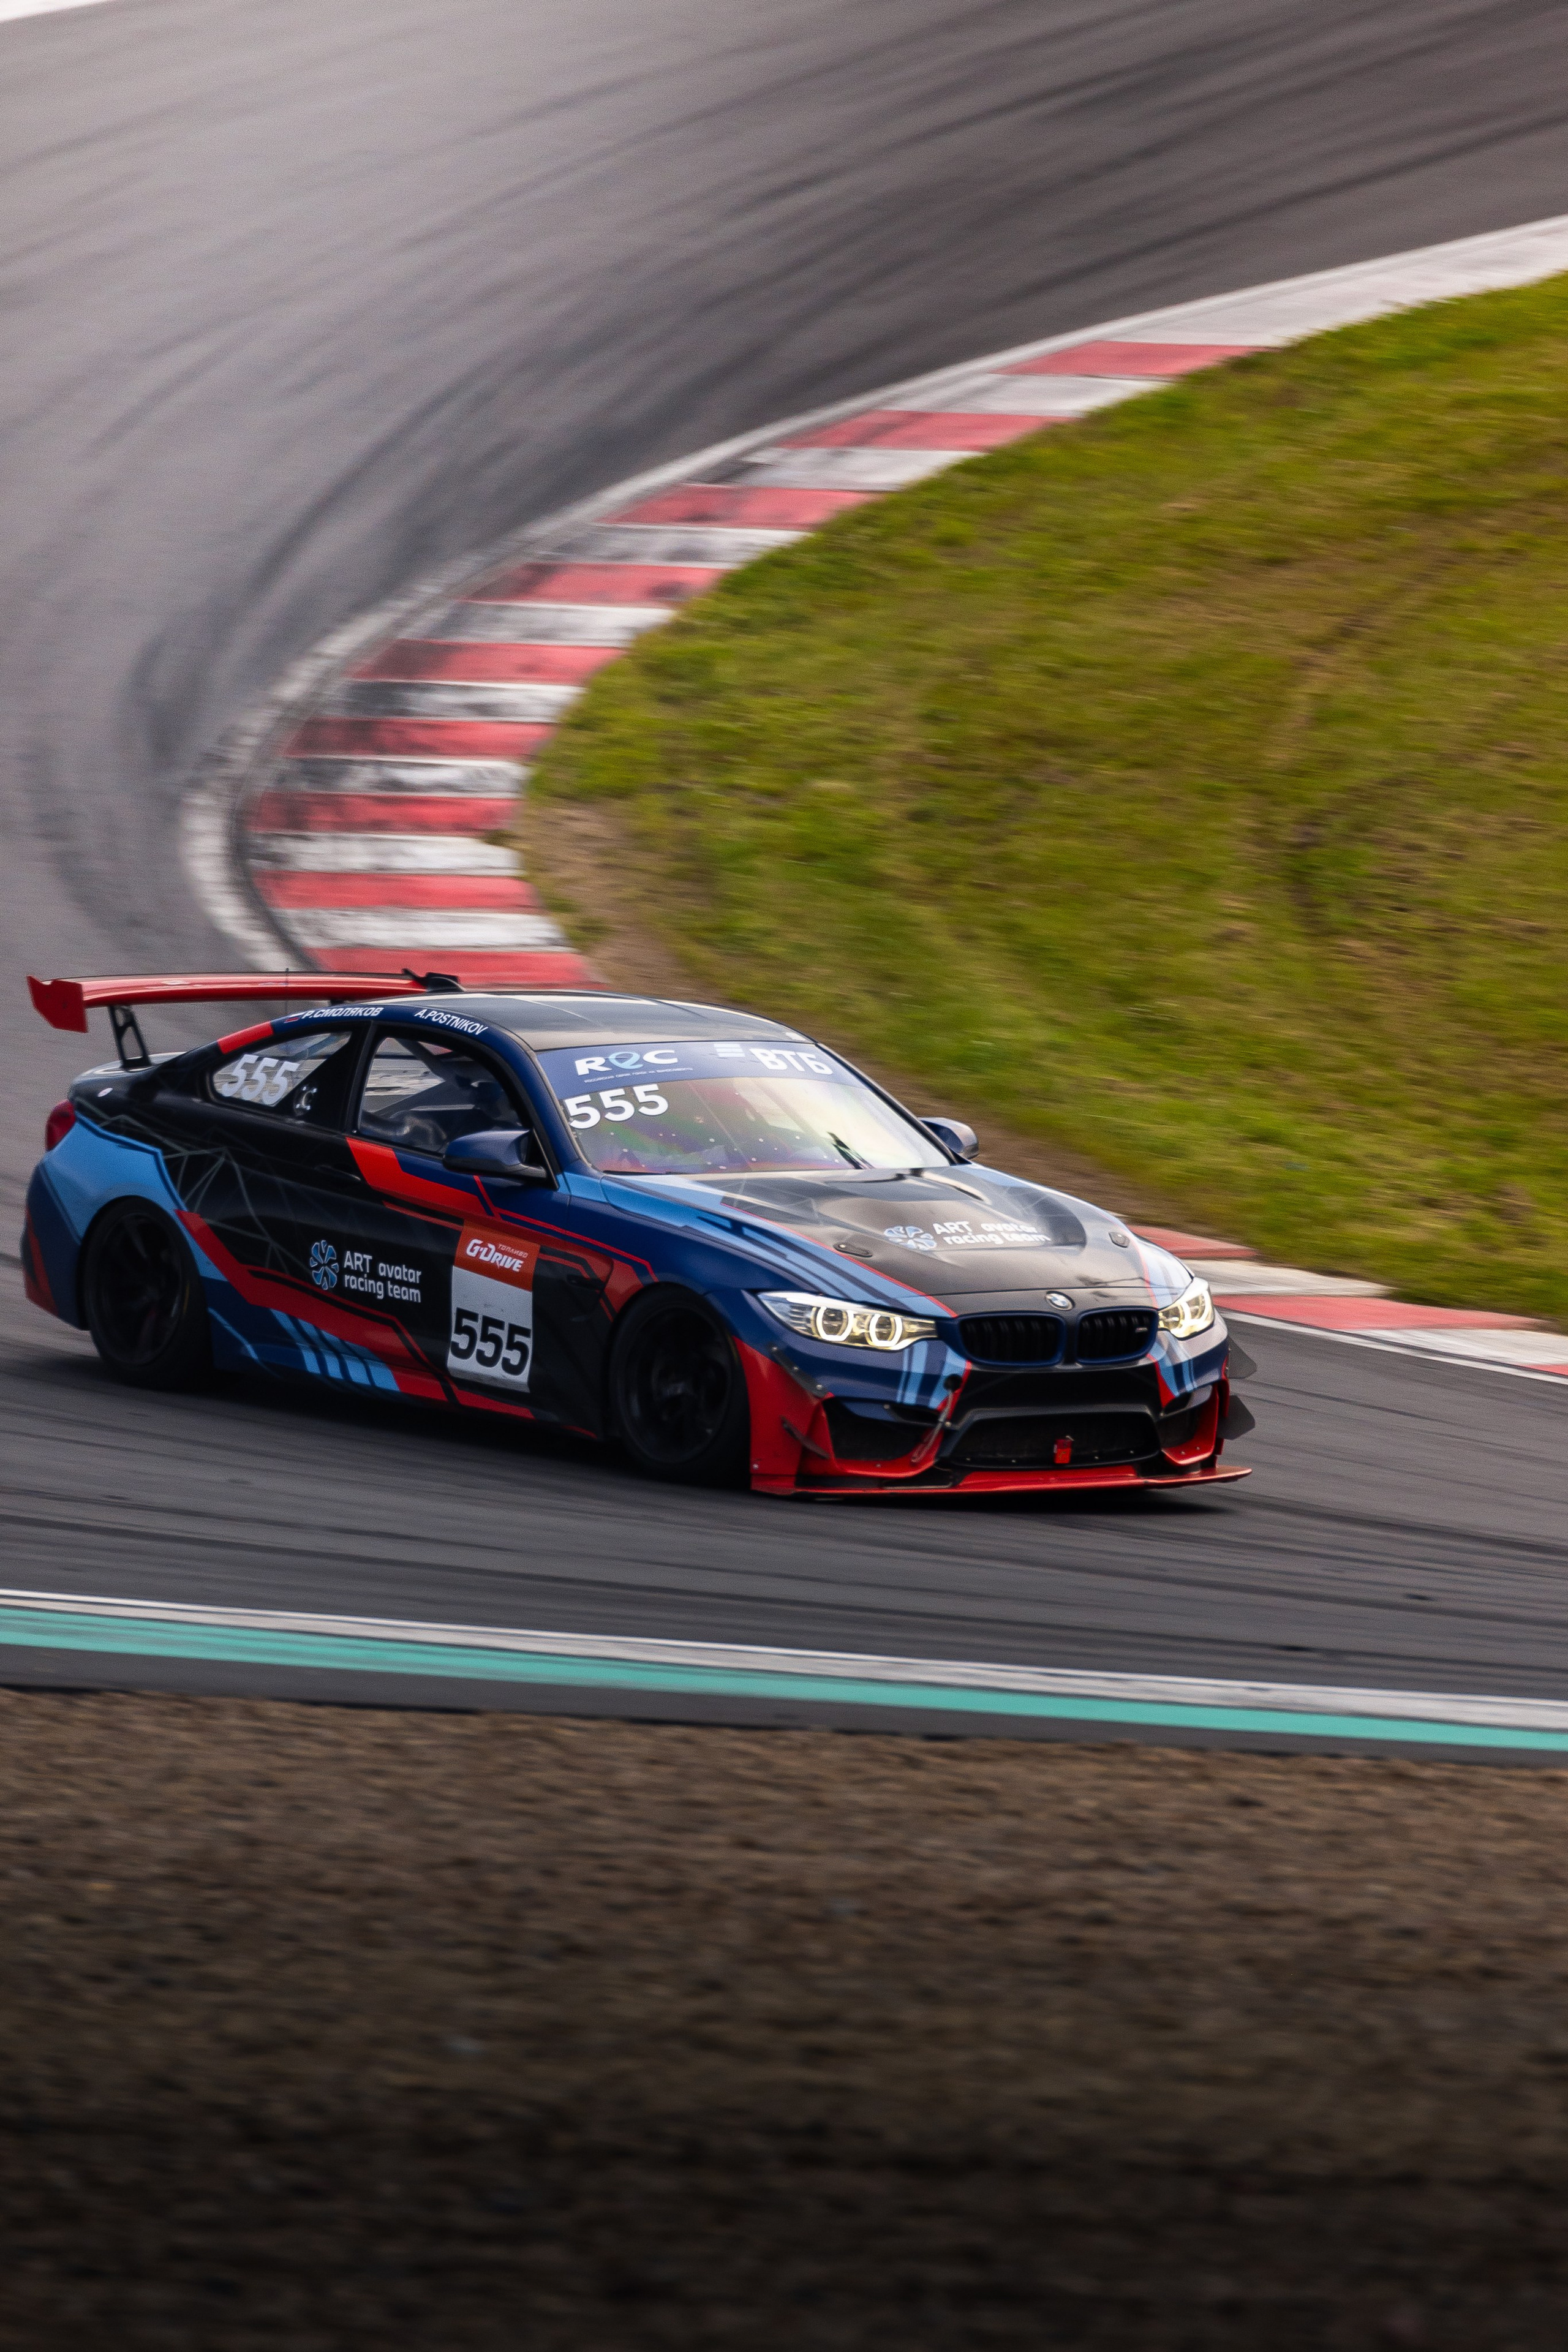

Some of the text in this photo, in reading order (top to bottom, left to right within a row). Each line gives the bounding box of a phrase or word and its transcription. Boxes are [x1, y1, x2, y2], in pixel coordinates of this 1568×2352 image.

[301, 1007, 384, 1019] Р.СМОЛЯКОВ
[414, 1009, 488, 1035] A.POSTNIKOV
[749, 1048, 833, 1075] ВТБ
[222, 1054, 300, 1104] 555
[564, 1084, 668, 1129] 555
[933, 1221, 1038, 1235] ART avatar
[943, 1232, 1051, 1245] racing team
[344, 1251, 422, 1284] ART avatar
[344, 1273, 421, 1303] racing team
[450, 1306, 532, 1376] 555
